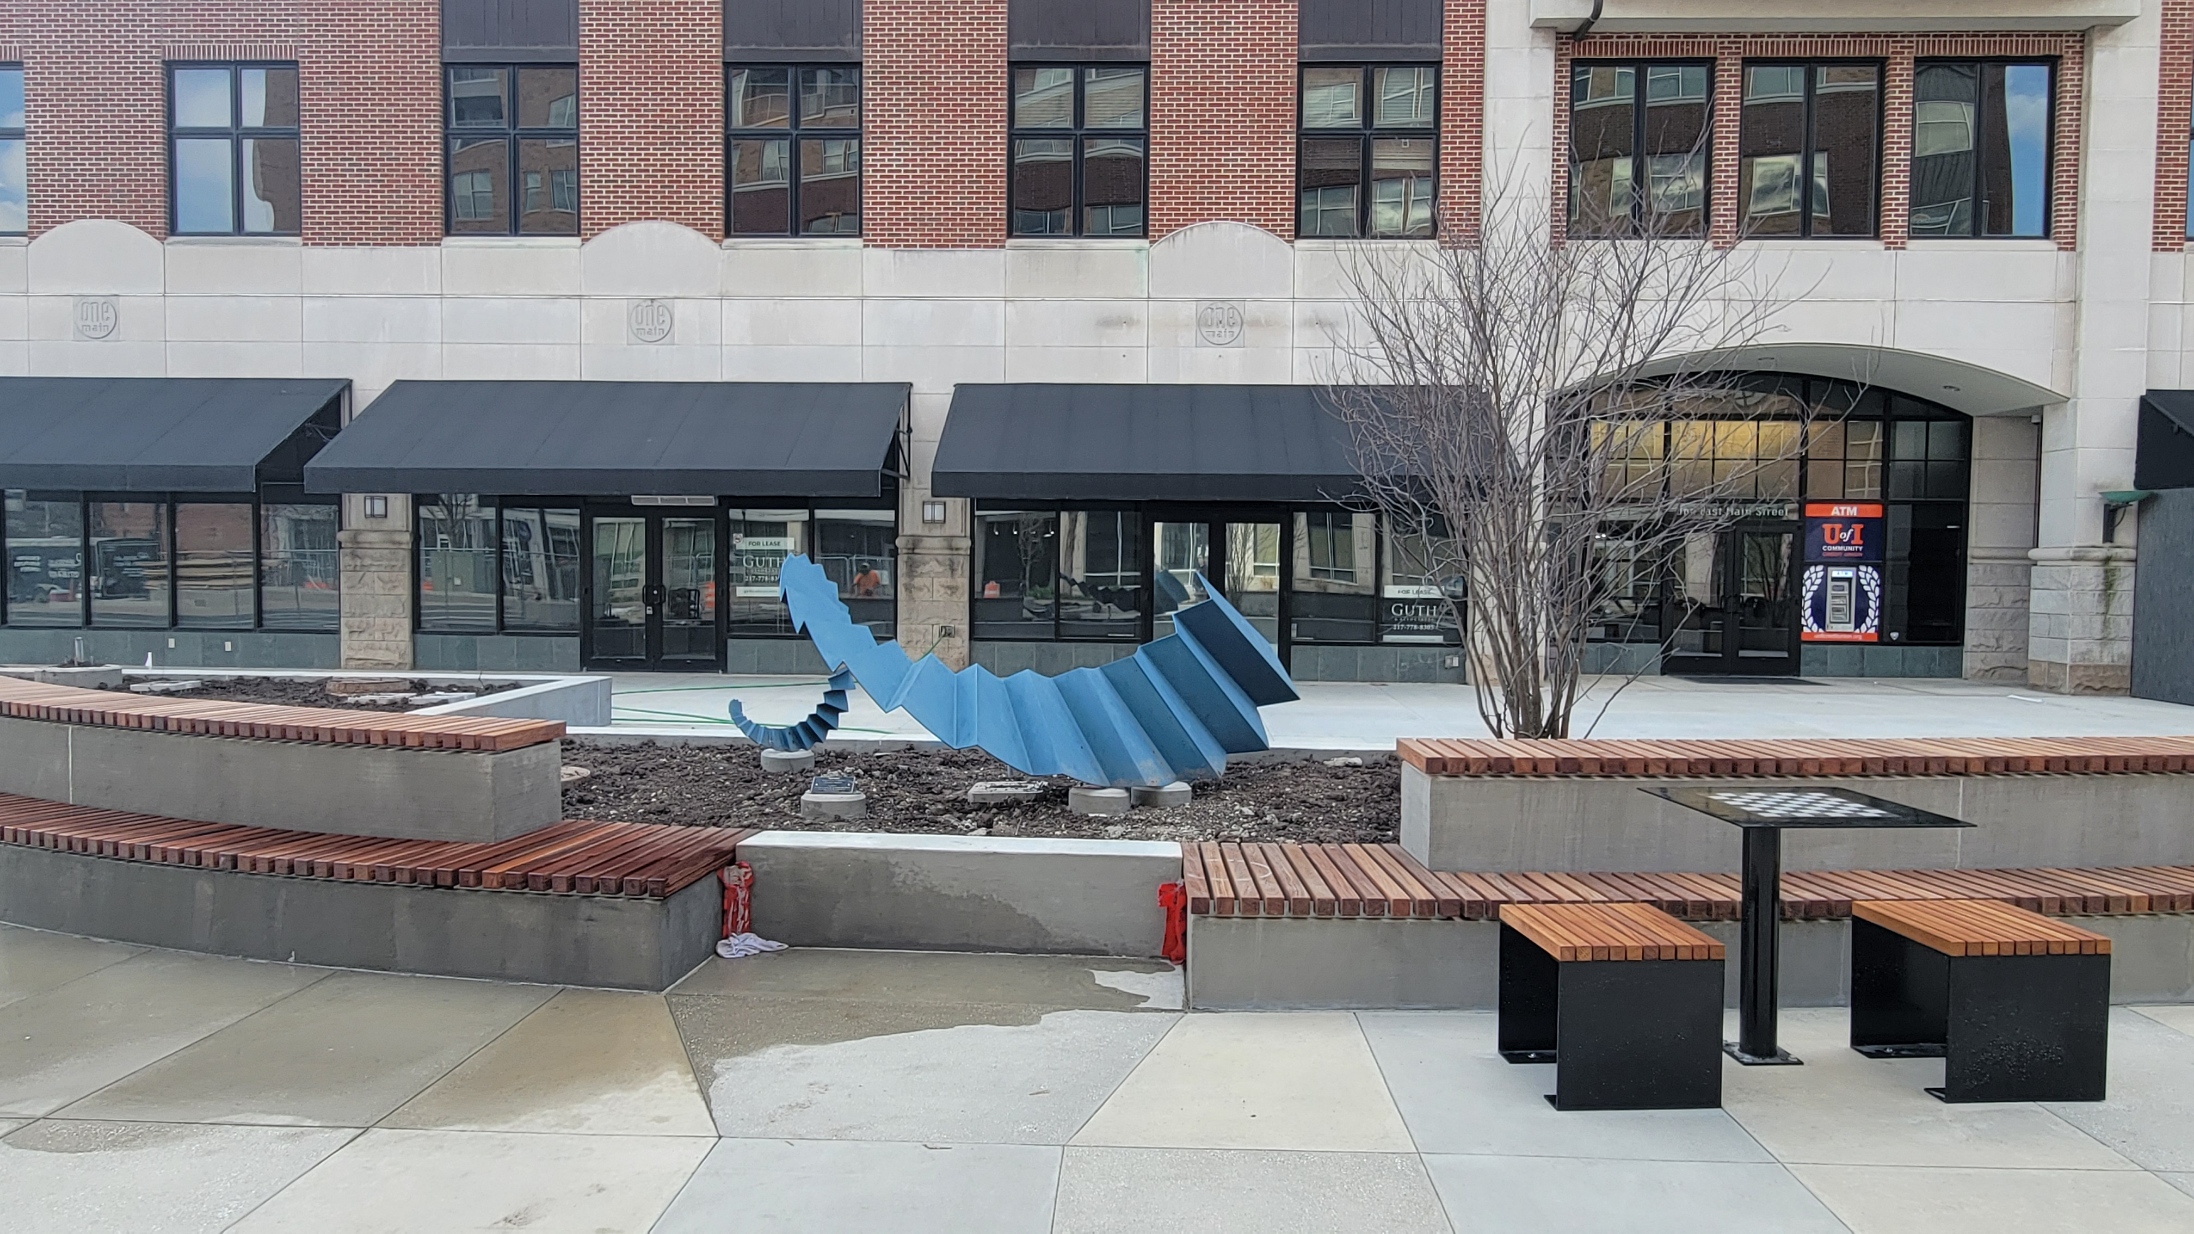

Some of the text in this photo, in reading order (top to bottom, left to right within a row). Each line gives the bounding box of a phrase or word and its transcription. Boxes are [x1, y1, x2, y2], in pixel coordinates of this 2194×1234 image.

[81, 301, 110, 323] one
[635, 304, 665, 327] one
[1755, 506, 1788, 516] Street
[1831, 505, 1858, 516] ATM
[1391, 603, 1437, 617] GUTH
